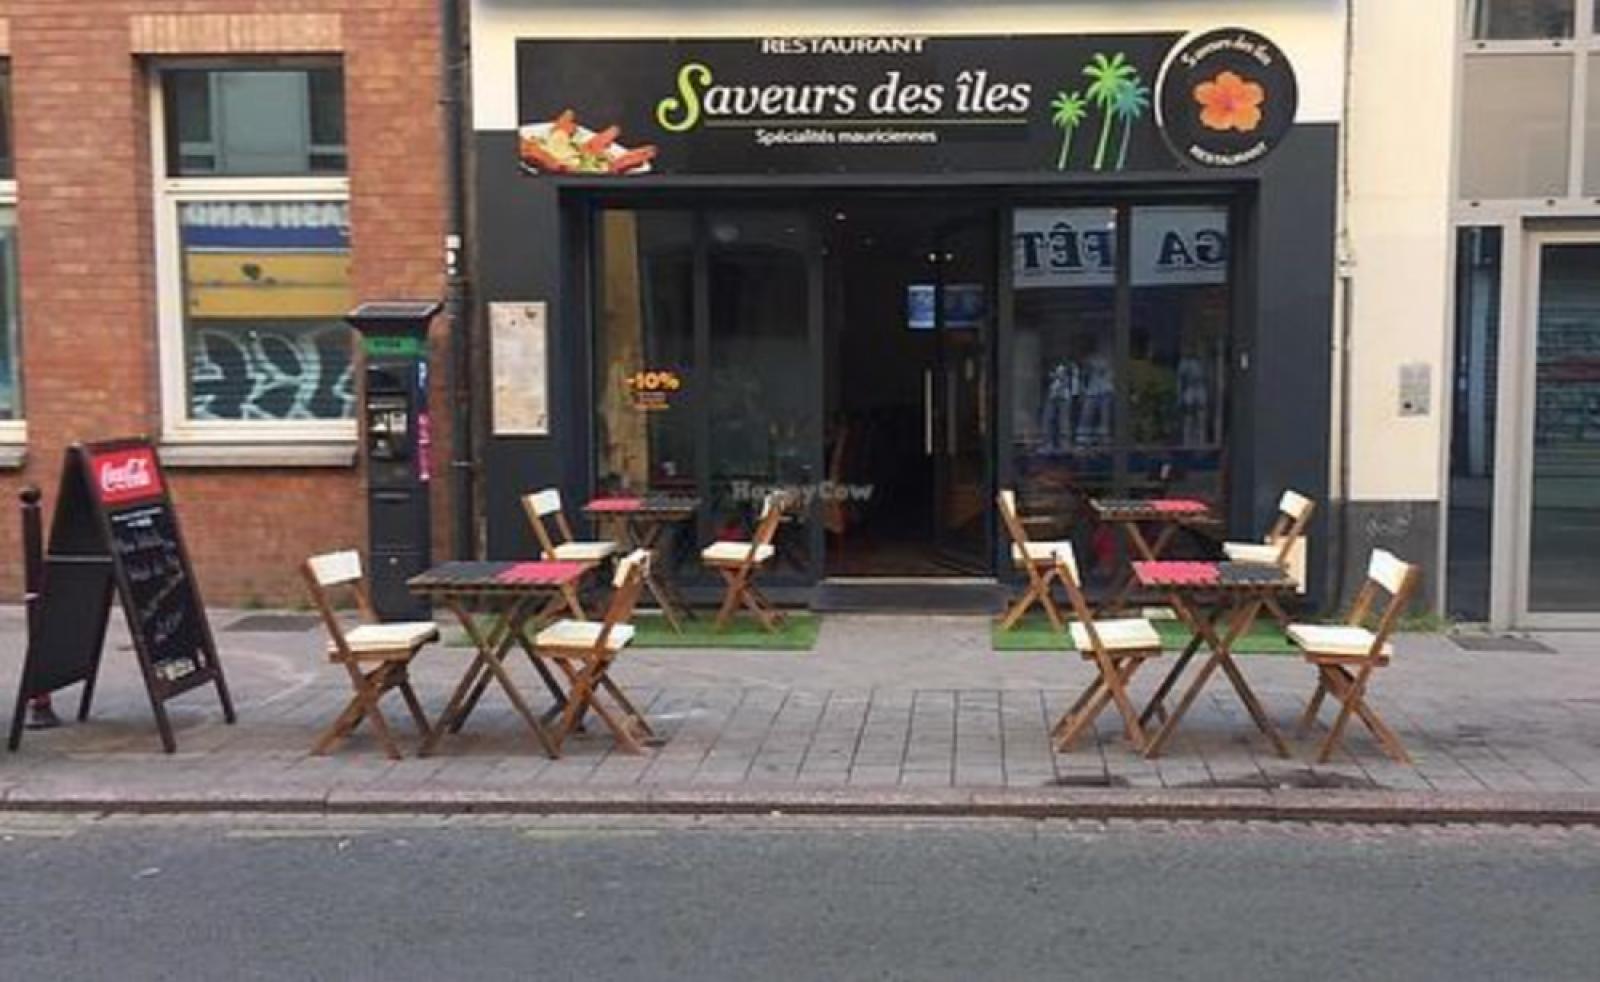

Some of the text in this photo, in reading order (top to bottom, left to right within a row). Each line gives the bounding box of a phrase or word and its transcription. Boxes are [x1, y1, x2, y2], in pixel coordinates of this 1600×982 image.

[761, 38, 925, 54] RESTAURANT
[657, 63, 1032, 132] Saveurs des îles
[755, 128, 937, 147] Spécialités mauriciennes
